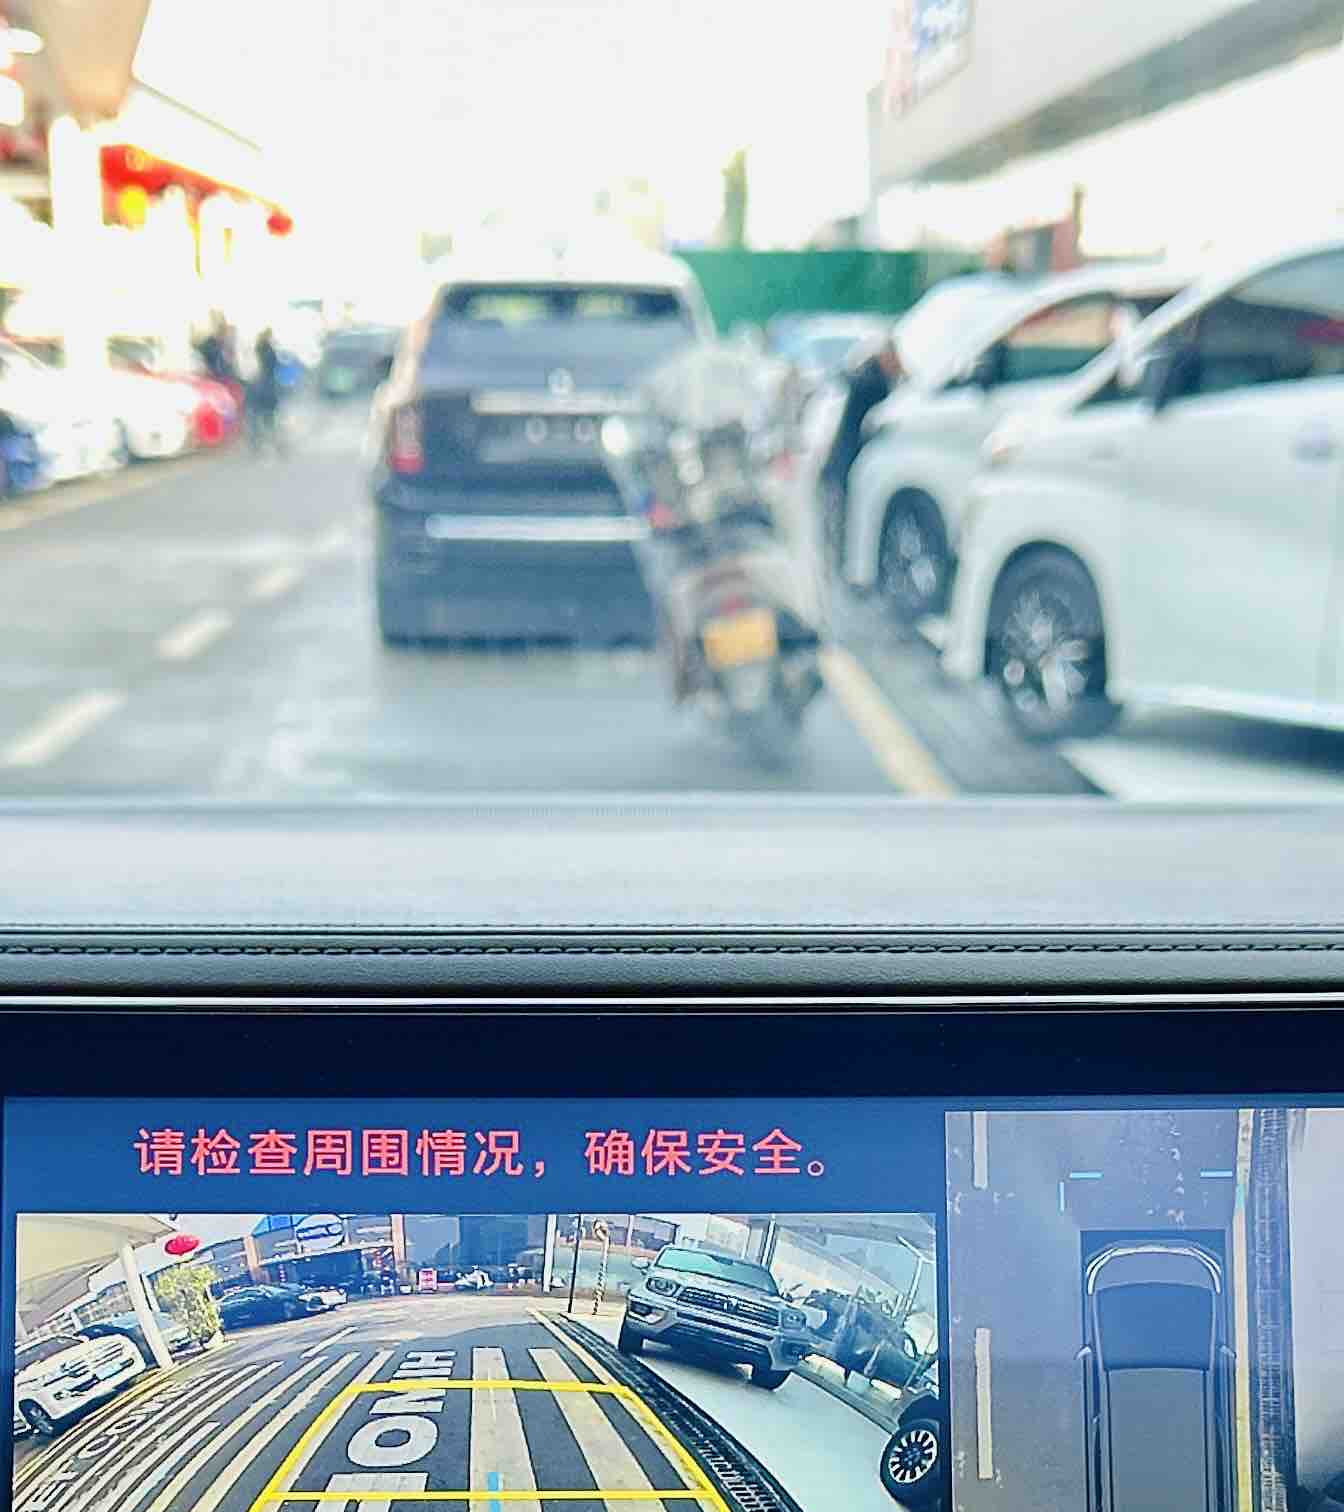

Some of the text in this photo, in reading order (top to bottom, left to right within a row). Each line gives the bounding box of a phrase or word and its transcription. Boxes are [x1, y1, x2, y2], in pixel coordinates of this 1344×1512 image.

[134, 1129, 824, 1178] 请检查周围情况，确保安全。
